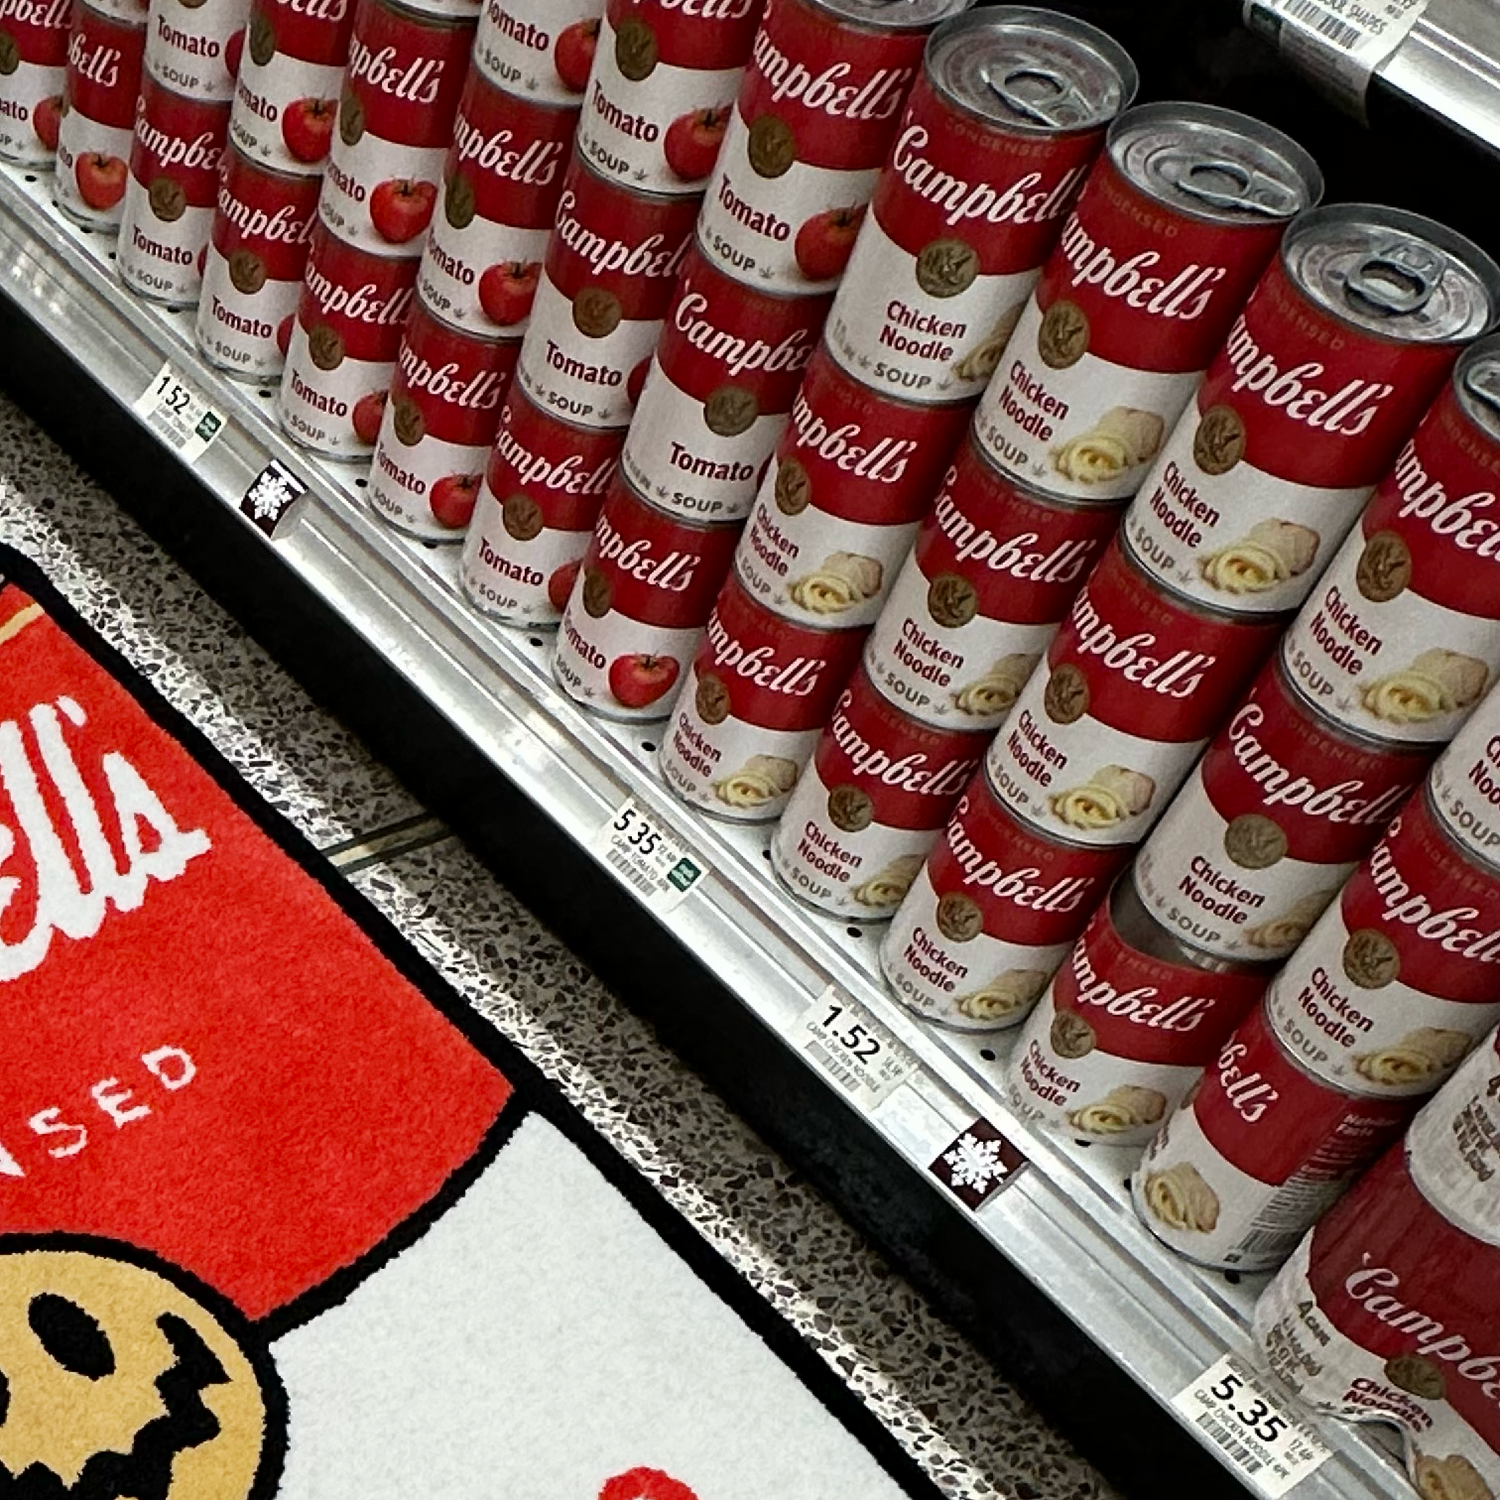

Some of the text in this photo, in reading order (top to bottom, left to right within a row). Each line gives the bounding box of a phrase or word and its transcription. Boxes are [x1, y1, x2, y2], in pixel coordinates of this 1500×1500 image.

[157, 14, 220, 58] Tomato
[162, 65, 200, 90] SOUP
[483, 49, 522, 83] SOUP
[592, 77, 660, 143] Tomato
[588, 140, 631, 176] SOUP
[716, 170, 792, 243] Tomato
[131, 224, 194, 267] Tomato
[712, 232, 756, 272] SOUP
[1060, 208, 1227, 321] ampbell's
[136, 269, 174, 293] SOUP
[211, 294, 274, 339] Tomato
[886, 299, 967, 339] Chicken
[214, 340, 251, 365] SOUP
[545, 339, 624, 388] Tomato
[878, 323, 955, 362] Noodle
[290, 367, 349, 417] Tomato
[873, 360, 933, 389] SOUP
[1009, 358, 1071, 421] Chicken
[1225, 312, 1395, 437] ampbell's
[290, 414, 327, 442] SOUP
[546, 390, 594, 418] SOUP
[997, 384, 1054, 442] Noodle
[670, 440, 755, 482] Tomato
[984, 425, 1030, 468] SOUP
[373, 485, 404, 518] SOUP
[671, 491, 724, 514] SOUP
[1149, 486, 1204, 550] Noodle
[1162, 459, 1221, 528] Chicken
[478, 535, 545, 588] Tomato
[1133, 526, 1176, 572] SOUP
[478, 582, 519, 610] SOUP
[1325, 584, 1383, 656] Chicken
[892, 638, 952, 688] Noodle
[902, 617, 965, 670] Chicken
[1071, 584, 1217, 700] ampbell's
[1309, 609, 1364, 677] Noodle
[883, 671, 931, 708] SOUP
[1290, 650, 1335, 699] SOUP
[1006, 729, 1054, 789] Noodle
[1017, 708, 1069, 771] Chicken
[993, 762, 1031, 806] SOUP
[796, 837, 852, 884] Noodle
[804, 819, 863, 869] Chicken
[789, 865, 832, 900] SOUP
[1178, 874, 1249, 926] Noodle
[1189, 854, 1266, 909] Chicken
[1166, 906, 1222, 944] SOUP
[903, 943, 957, 995] Noodle
[911, 925, 969, 980] Chicken
[894, 970, 936, 1008] SOUP
[1310, 965, 1375, 1034] Chicken
[822, 1003, 881, 1065] 1.52
[1283, 1016, 1329, 1064] SOUP
[1297, 985, 1357, 1049] Noodle
[1019, 1056, 1068, 1107] Noodle
[1028, 1038, 1082, 1094] Chicken
[1007, 1083, 1046, 1123] SOUP
[1210, 1373, 1288, 1443] 5.35
